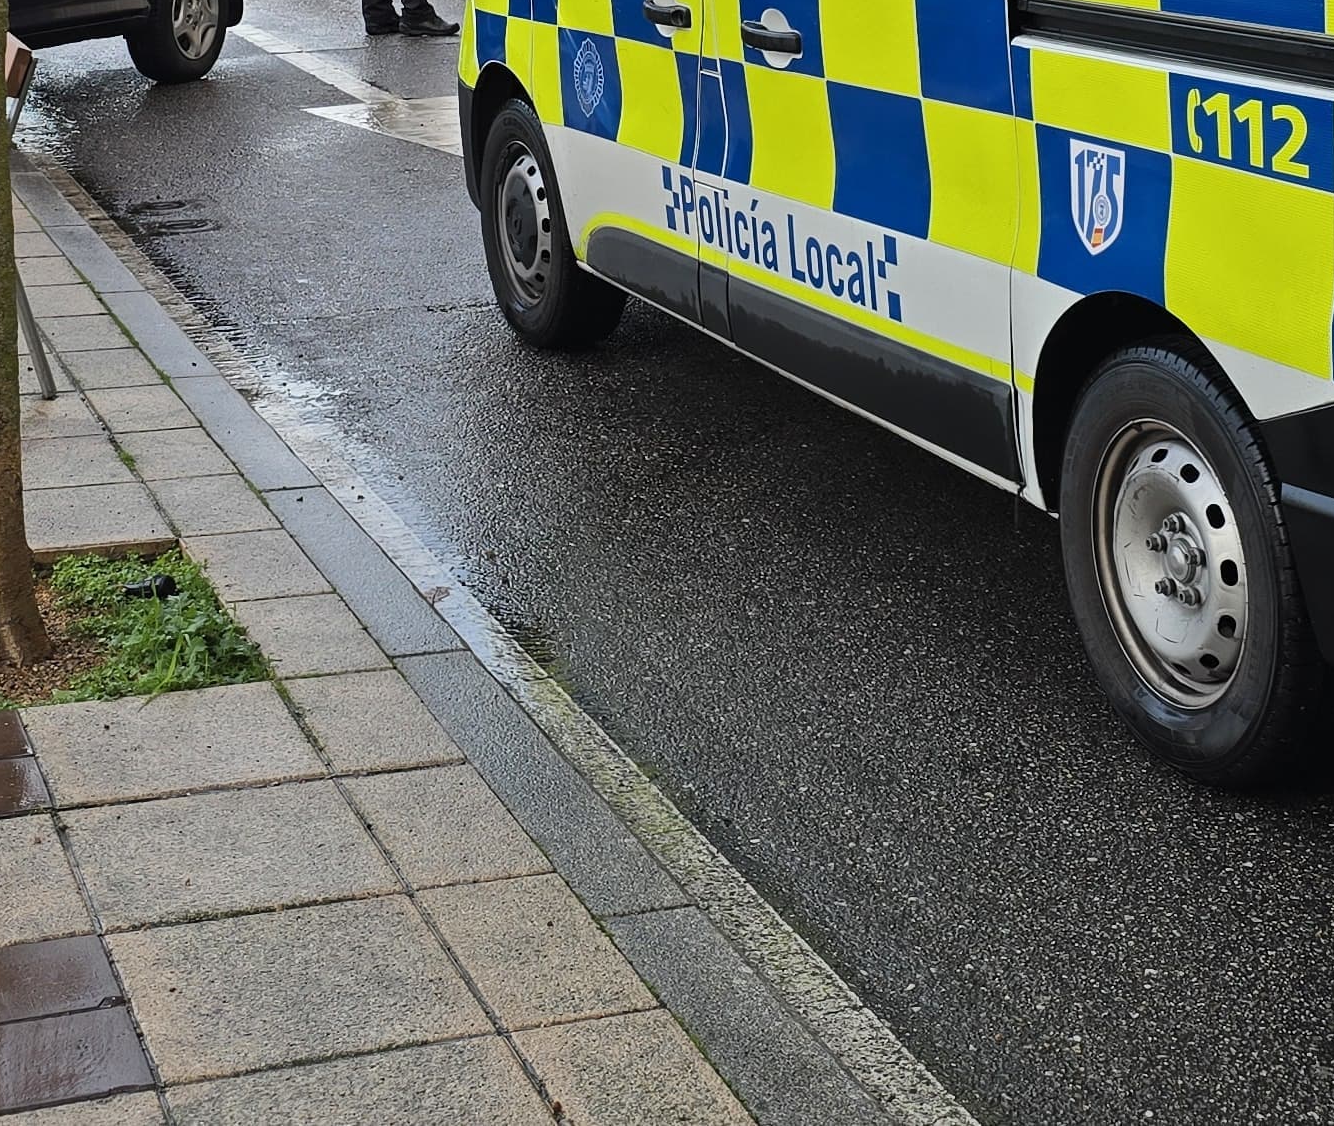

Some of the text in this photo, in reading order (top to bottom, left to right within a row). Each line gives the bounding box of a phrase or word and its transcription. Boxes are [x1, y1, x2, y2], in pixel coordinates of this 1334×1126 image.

[1202, 92, 1310, 179] 112
[679, 174, 878, 311] Policía Local
